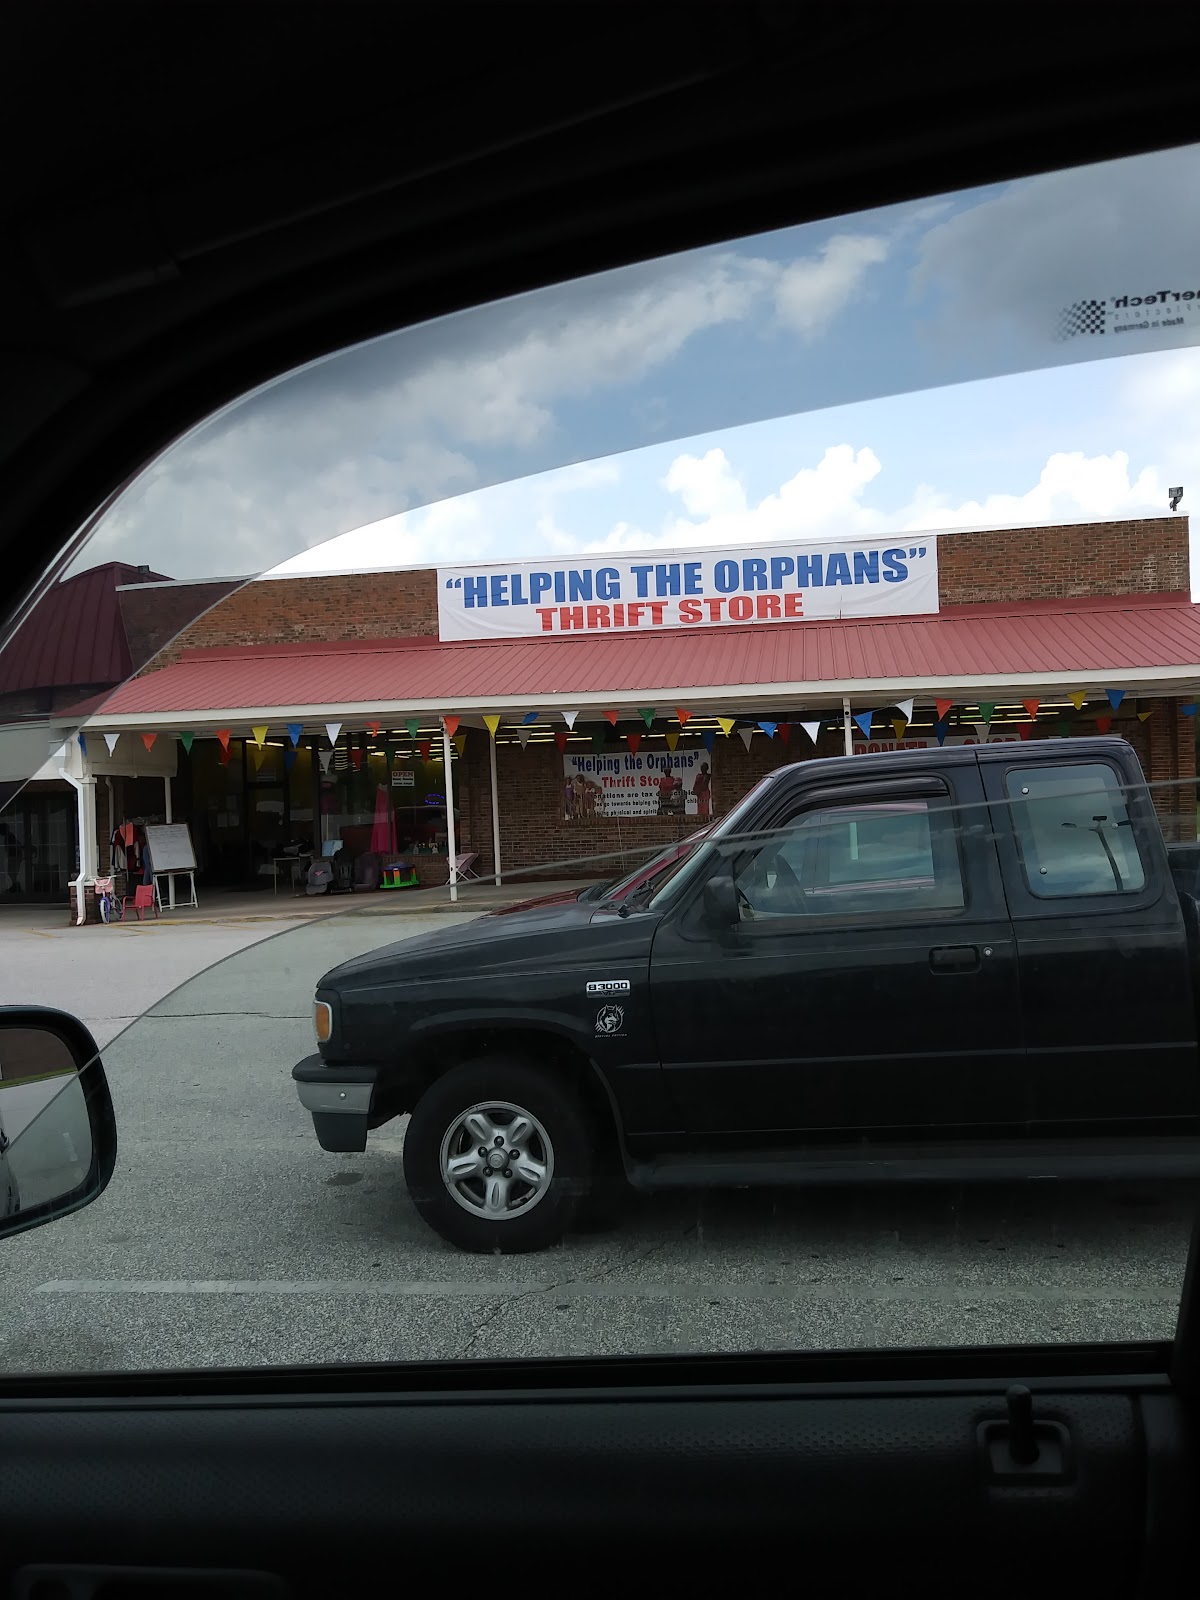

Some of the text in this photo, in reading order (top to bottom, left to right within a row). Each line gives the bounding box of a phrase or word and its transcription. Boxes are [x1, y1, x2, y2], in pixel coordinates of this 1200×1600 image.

[446, 547, 928, 609] “HELPING THE ORPHANS”
[535, 593, 804, 632] THRIFT STORE
[571, 751, 699, 775] “Helping the Orphans”
[601, 775, 660, 788] Thrift Sto
